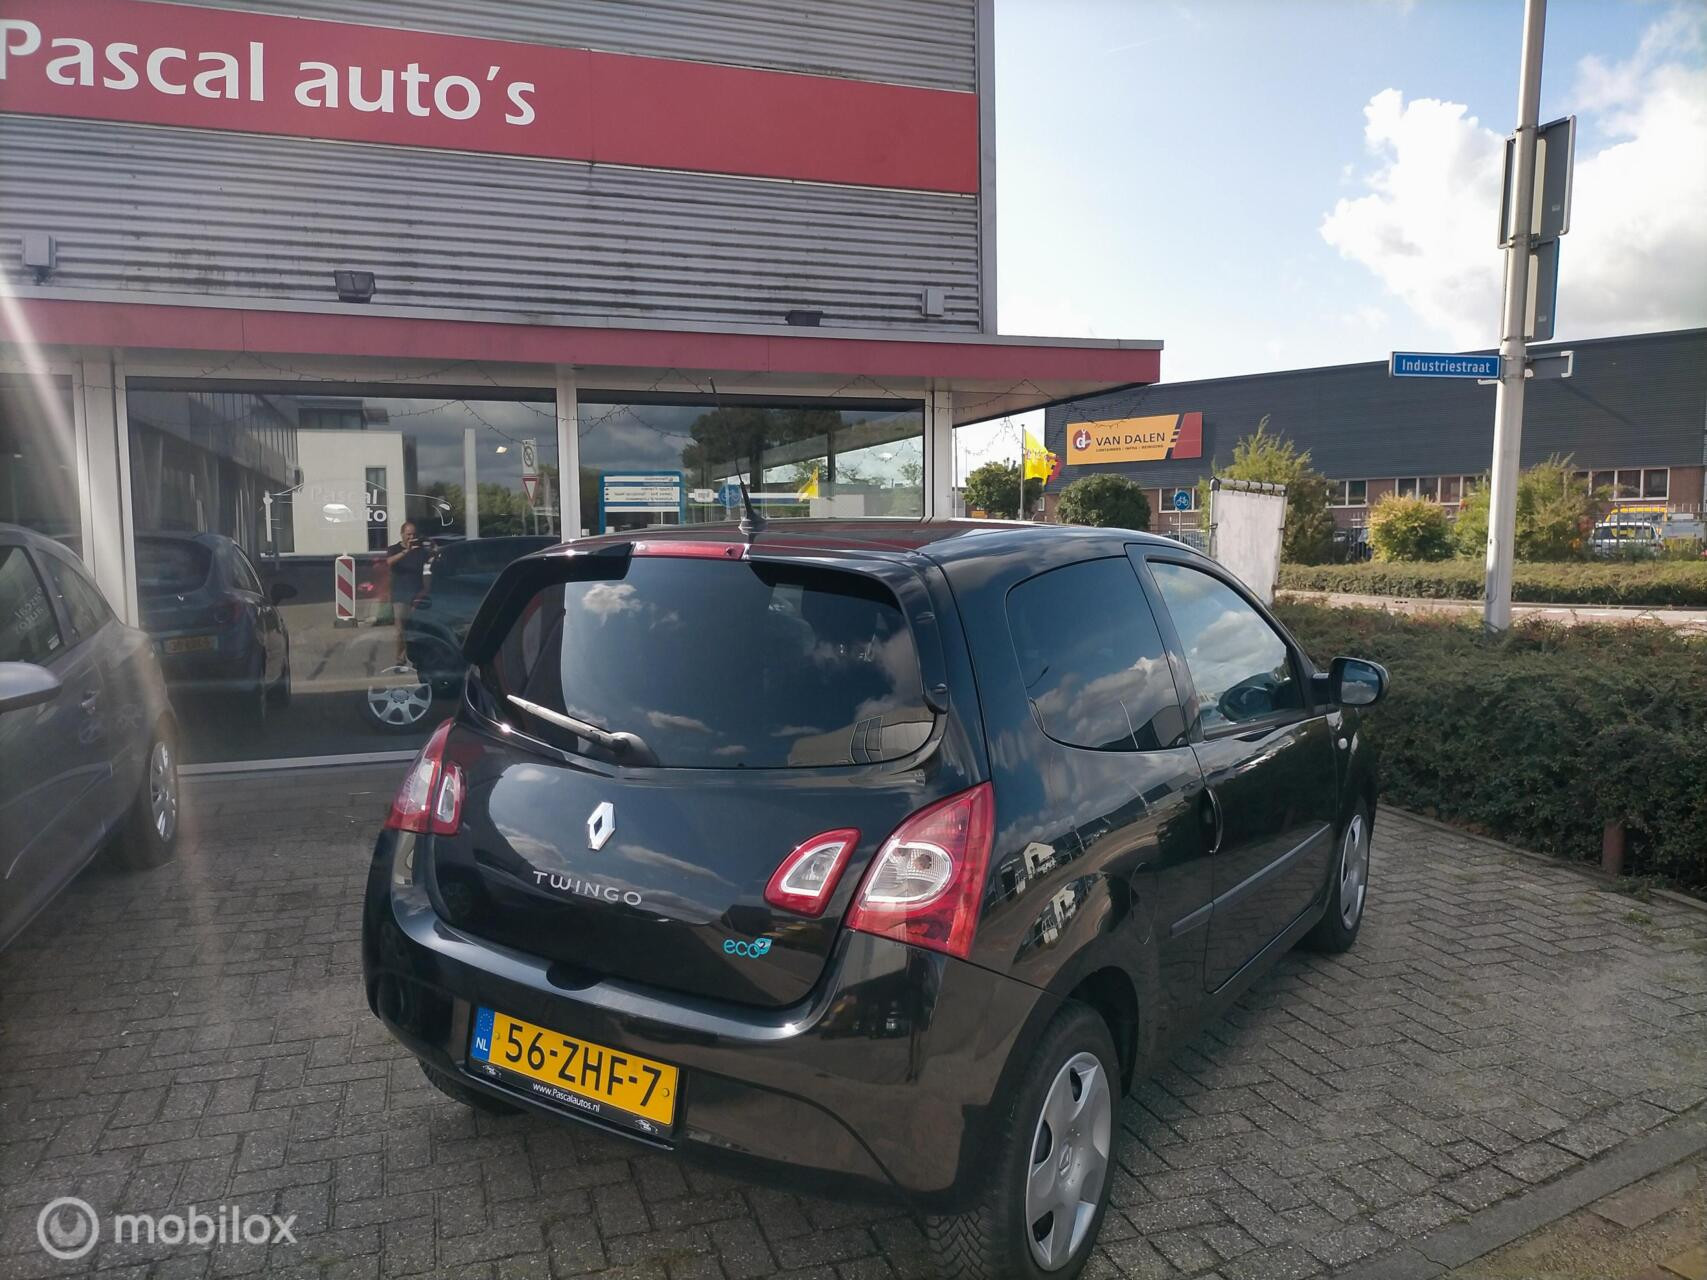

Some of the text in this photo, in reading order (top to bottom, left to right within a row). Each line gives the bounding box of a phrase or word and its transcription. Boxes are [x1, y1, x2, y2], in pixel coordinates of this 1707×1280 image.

[0, 19, 536, 126] Pascal auto's
[1402, 359, 1490, 373] Industriestraat
[1096, 432, 1165, 446] VAN DALEN
[533, 871, 642, 906] TWINGO
[475, 1036, 488, 1051] NL
[505, 1023, 662, 1107] 56-ZHF-7
[533, 1083, 600, 1112] www.Pascalautos.nl
